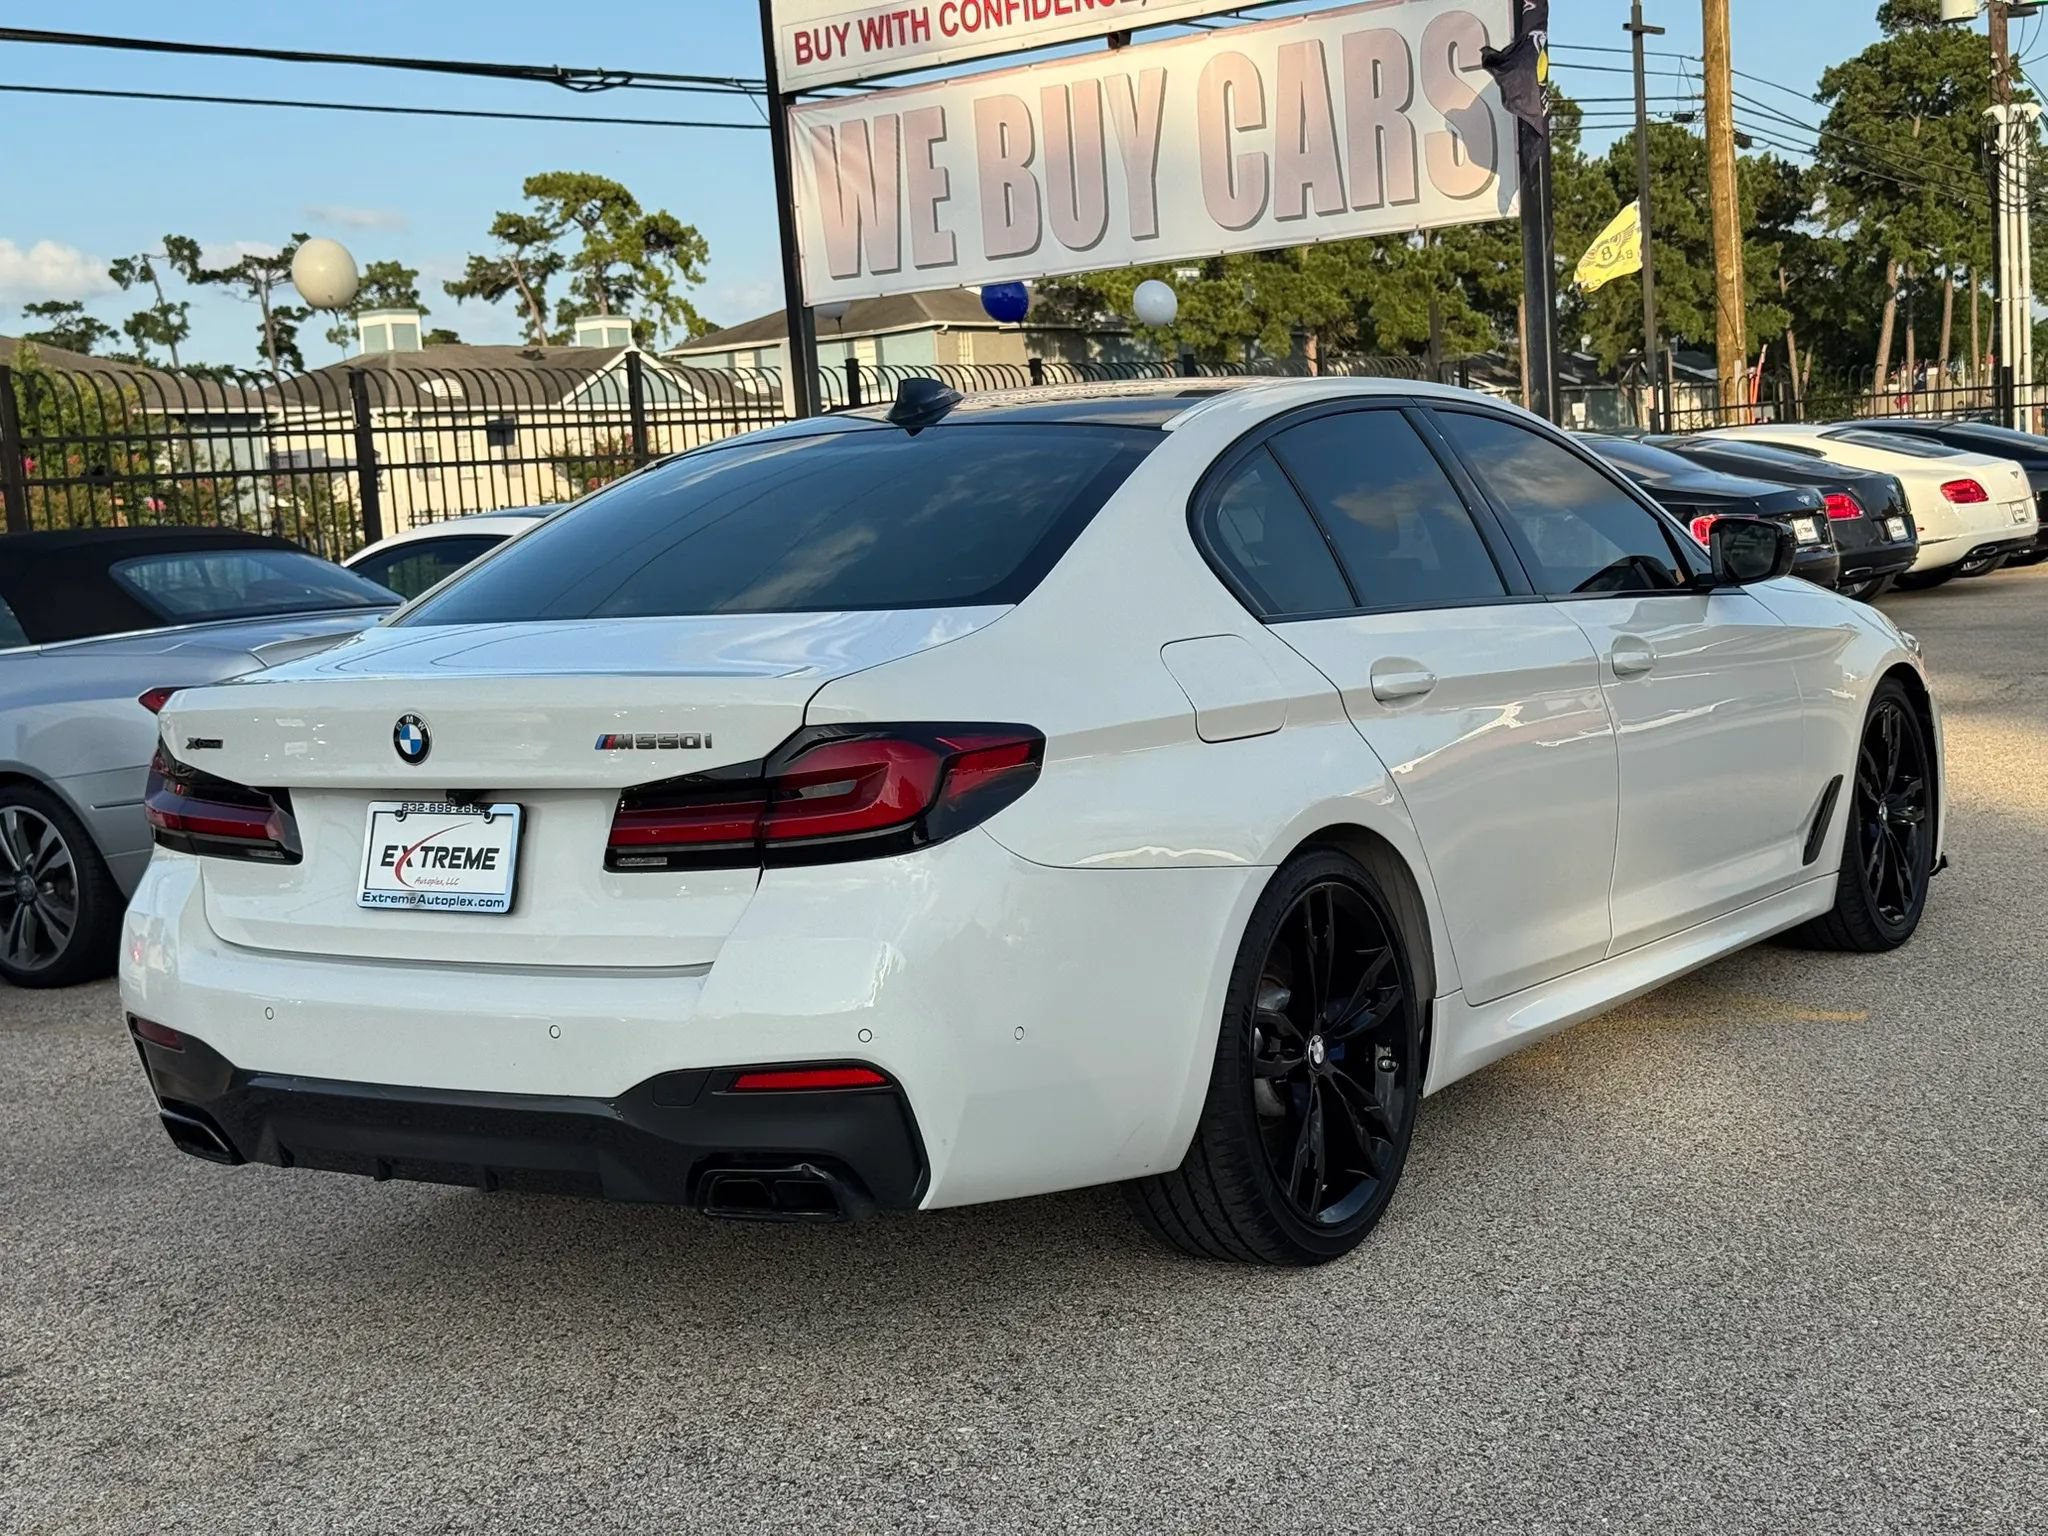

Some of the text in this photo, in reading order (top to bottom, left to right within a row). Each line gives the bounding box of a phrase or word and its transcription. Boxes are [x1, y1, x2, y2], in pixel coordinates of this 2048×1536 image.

[794, 22, 850, 65] BUY
[857, 7, 931, 52] WITH
[809, 10, 1498, 280] WE BUY CARS
[380, 845, 500, 871] EXTREME
[362, 892, 505, 908] ExtremeAutoplex.com
